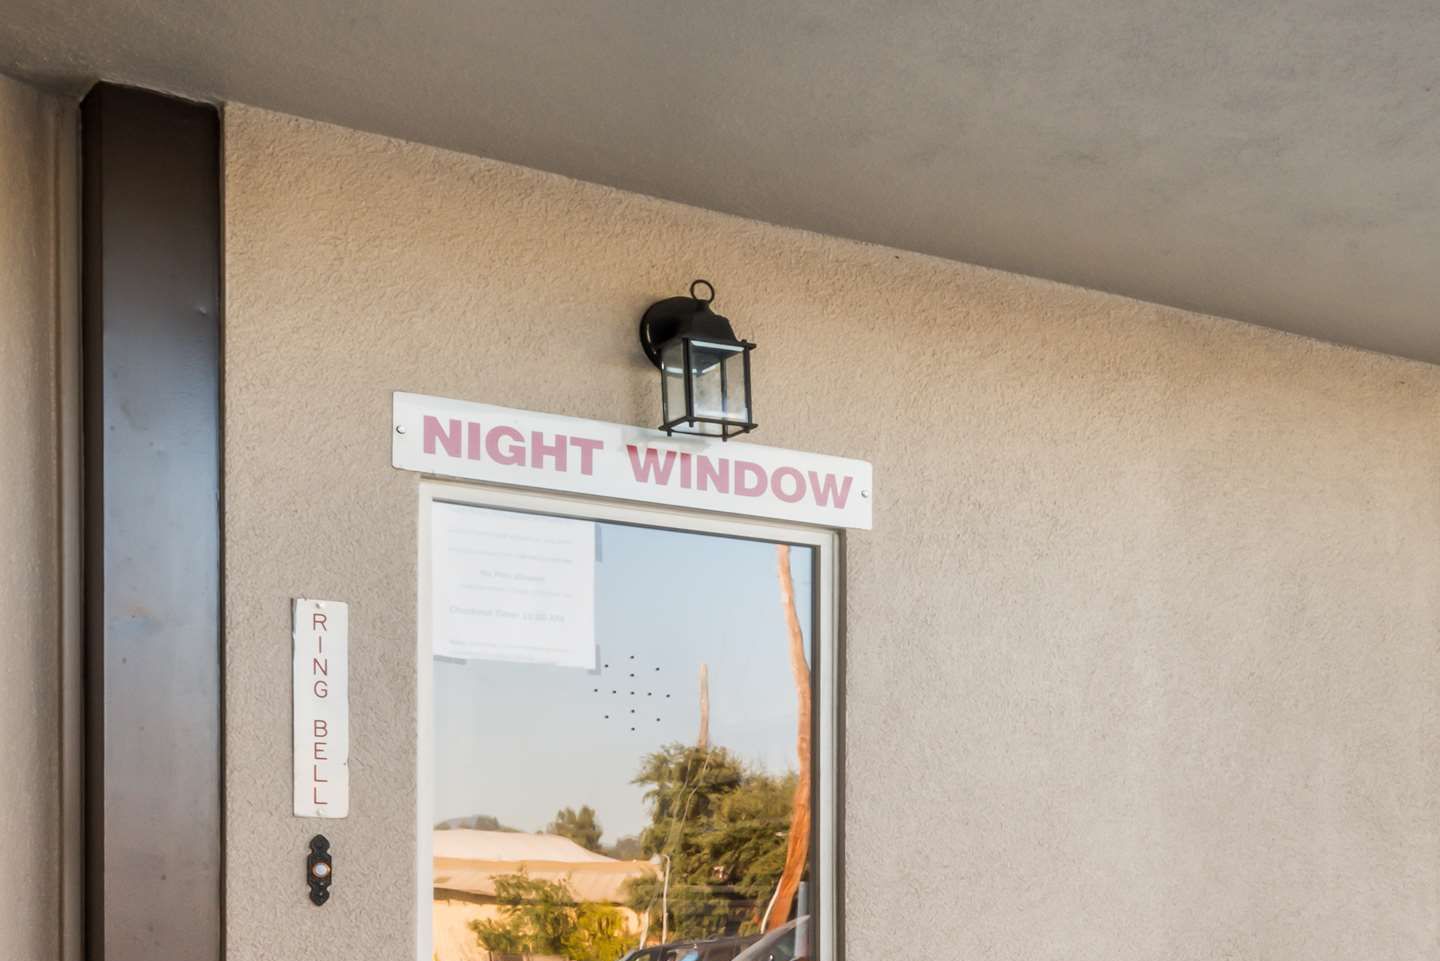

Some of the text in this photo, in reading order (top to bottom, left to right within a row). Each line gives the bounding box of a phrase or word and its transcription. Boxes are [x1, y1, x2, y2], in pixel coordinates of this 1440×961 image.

[422, 414, 854, 510] NIGHT WINDOW
[312, 613, 328, 805] RING BELL
